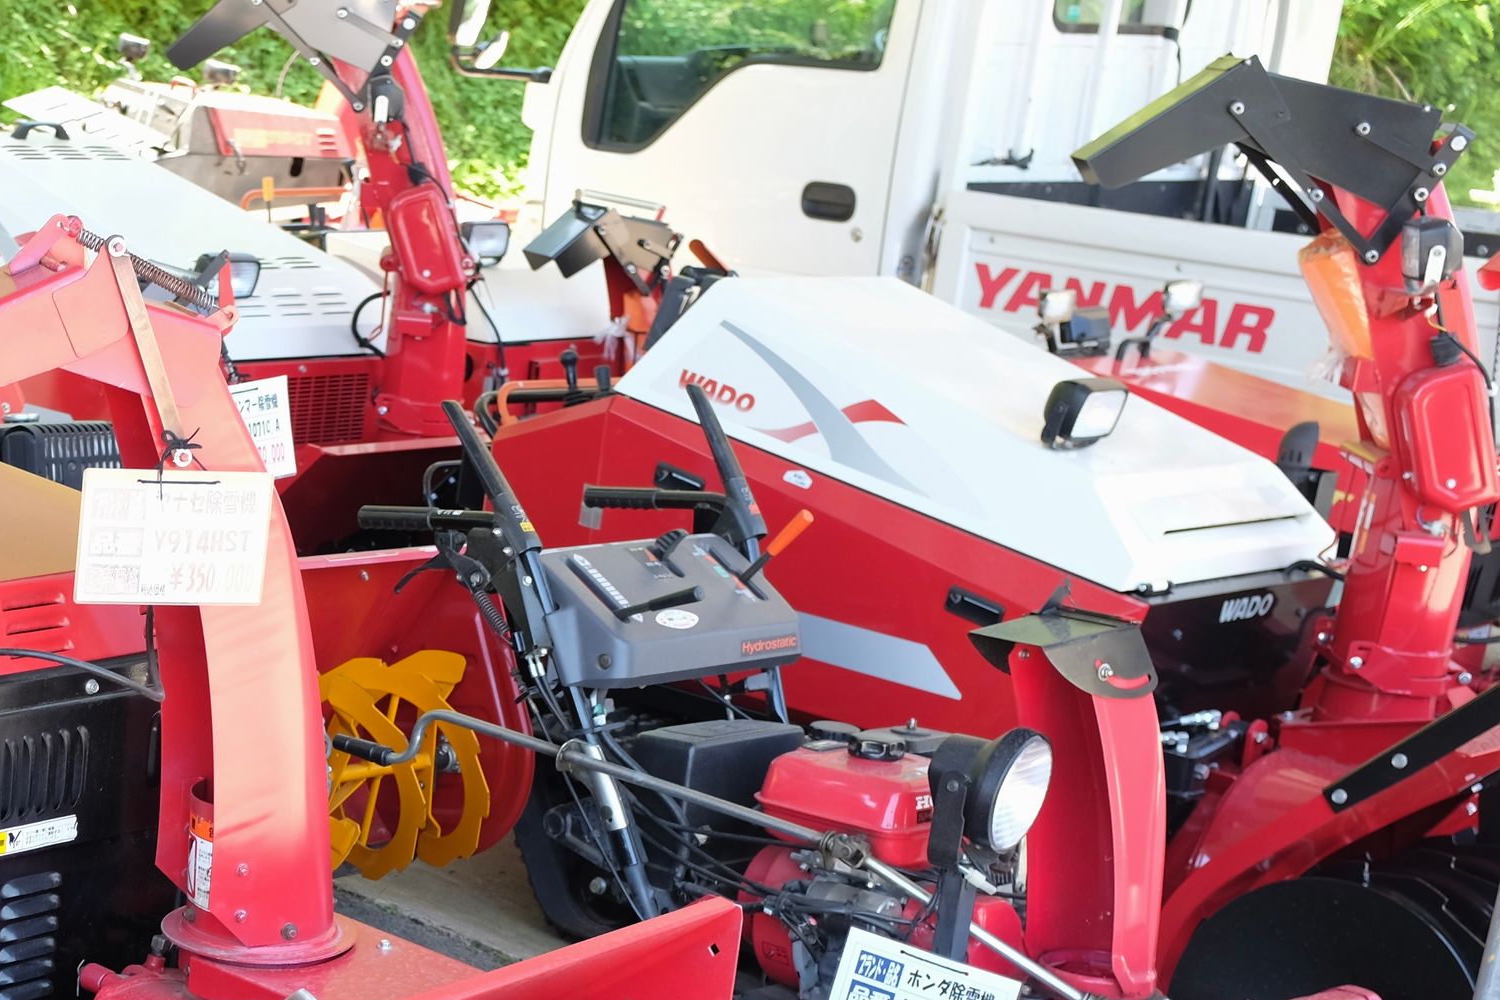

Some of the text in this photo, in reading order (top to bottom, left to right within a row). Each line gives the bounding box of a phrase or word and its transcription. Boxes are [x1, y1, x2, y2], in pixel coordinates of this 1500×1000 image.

[155, 529, 253, 555] Y914HST
[1219, 592, 1274, 624] WADO
[742, 634, 797, 653] Hydrostatic
